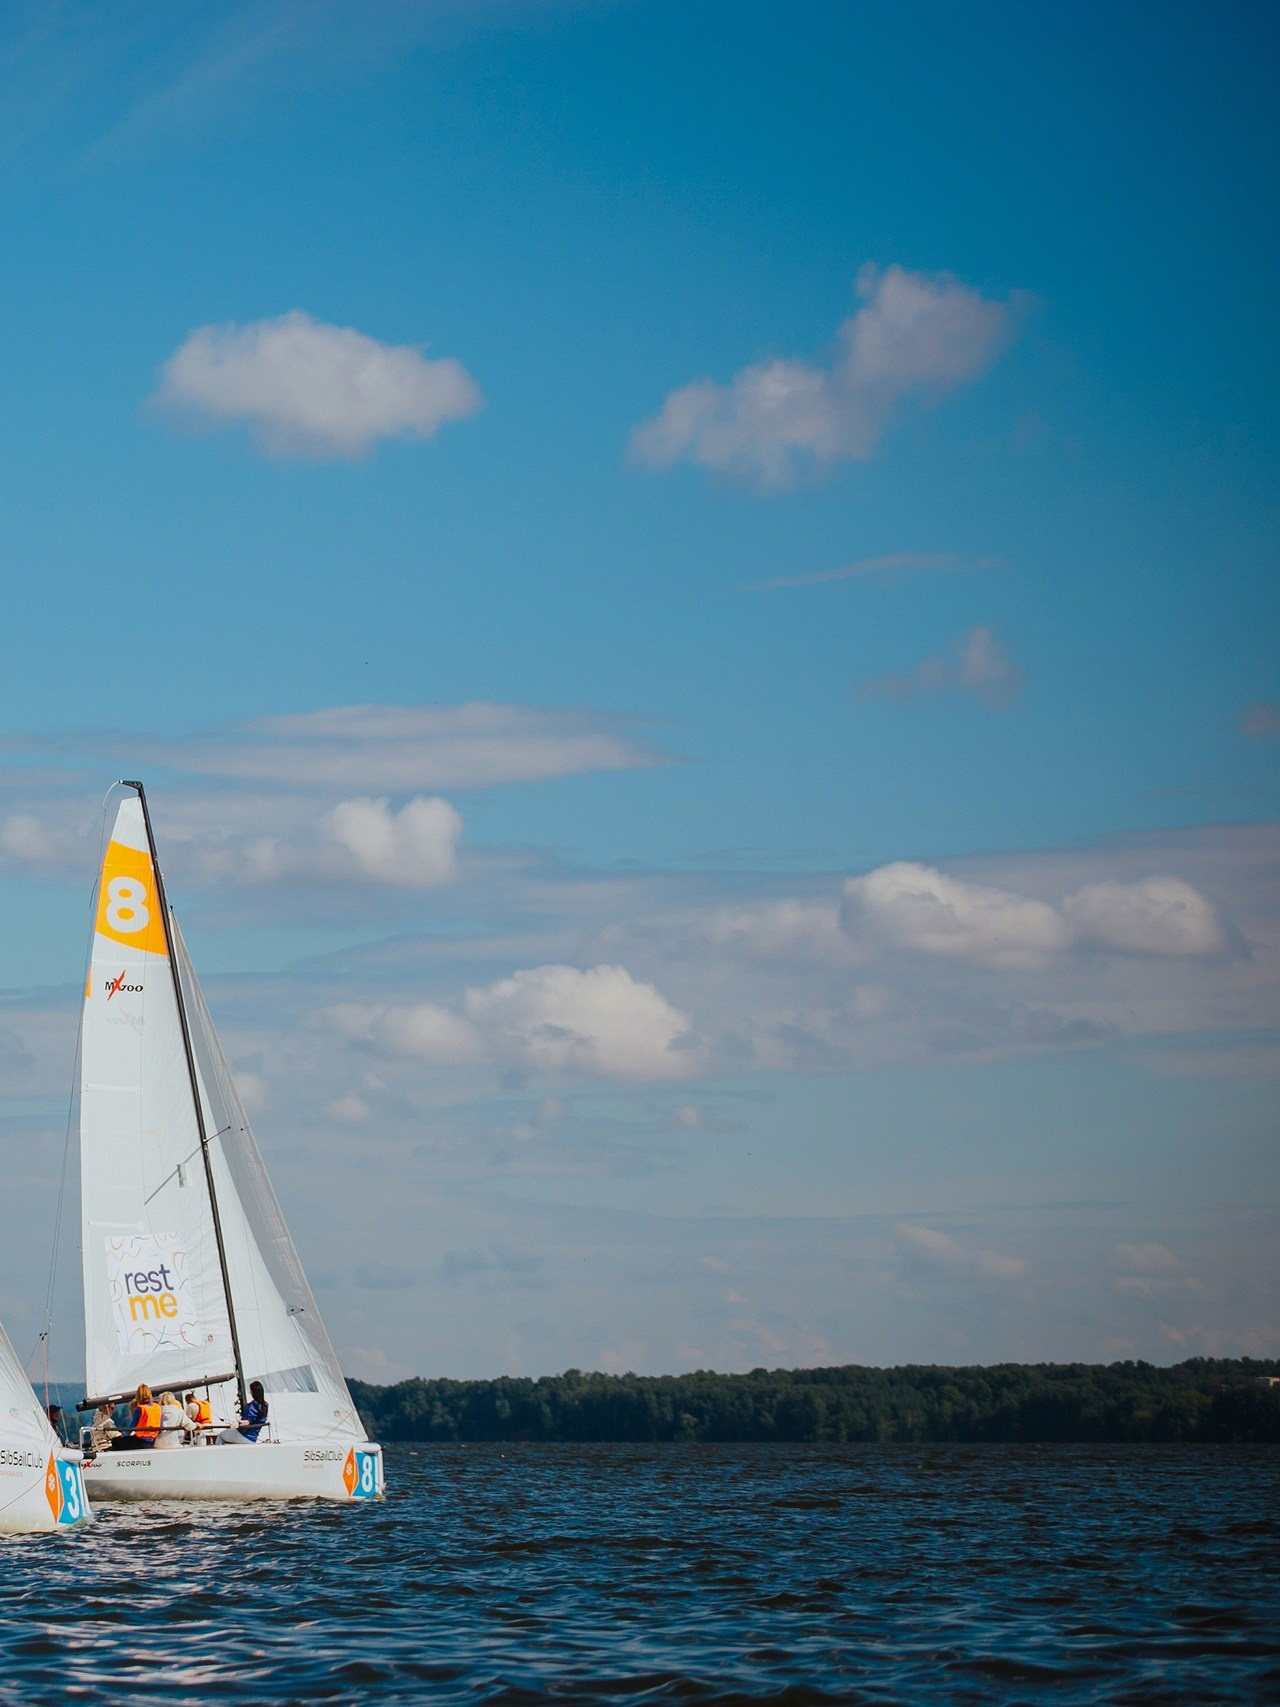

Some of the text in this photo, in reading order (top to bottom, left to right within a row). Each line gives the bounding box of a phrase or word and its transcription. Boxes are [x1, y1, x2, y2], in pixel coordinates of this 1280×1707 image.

[106, 876, 150, 934] 8
[124, 1263, 175, 1294] rest
[128, 1292, 178, 1321] me
[0, 1449, 43, 1469] SibSailClub
[116, 1460, 152, 1468] SCORPIUS
[361, 1455, 373, 1493] 8
[65, 1466, 80, 1519] 3
